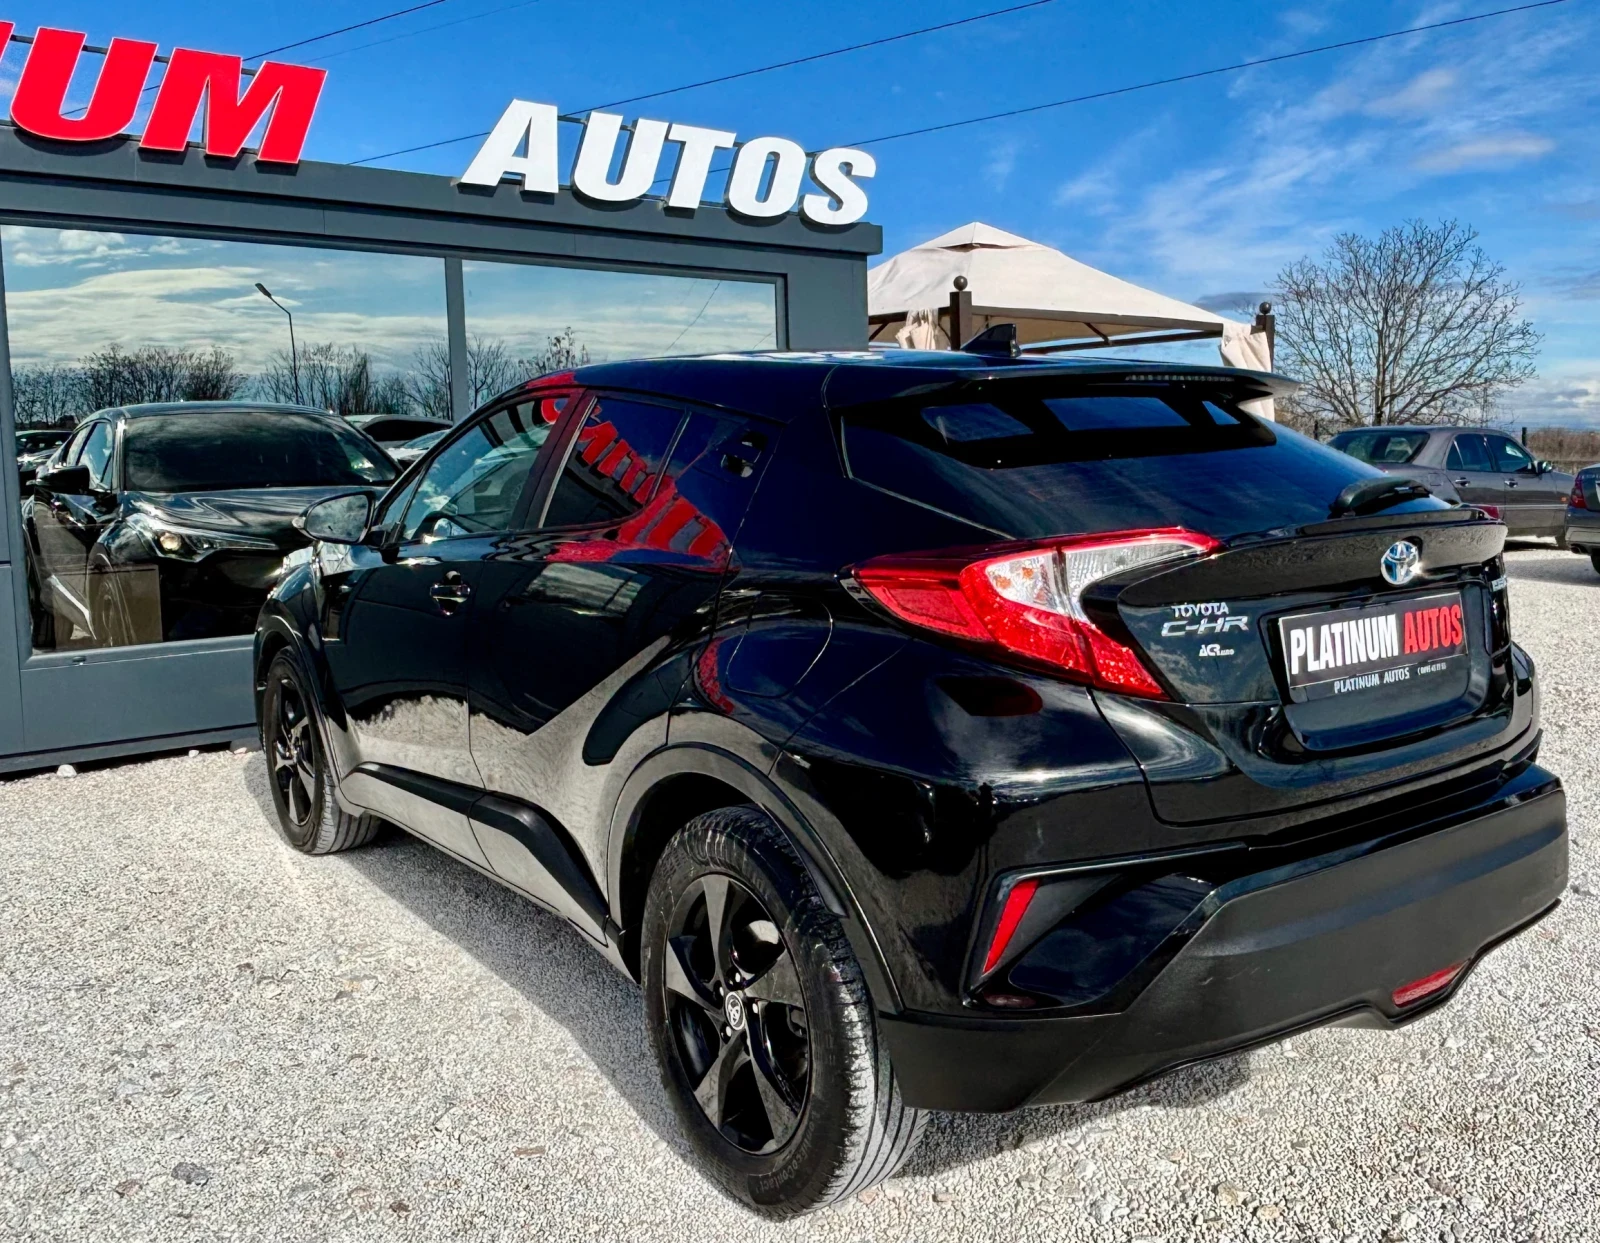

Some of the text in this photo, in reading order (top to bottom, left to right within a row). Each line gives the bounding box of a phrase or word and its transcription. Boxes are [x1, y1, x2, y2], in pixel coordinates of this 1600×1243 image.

[0, 20, 877, 226] UM AUTOS
[1170, 602, 1229, 618] TOYOTA
[1161, 615, 1249, 637] C-HR
[1290, 603, 1463, 675] PLATINUM AUTOS
[1333, 673, 1380, 694] PLATINUM
[1383, 667, 1410, 684] AUTOS
